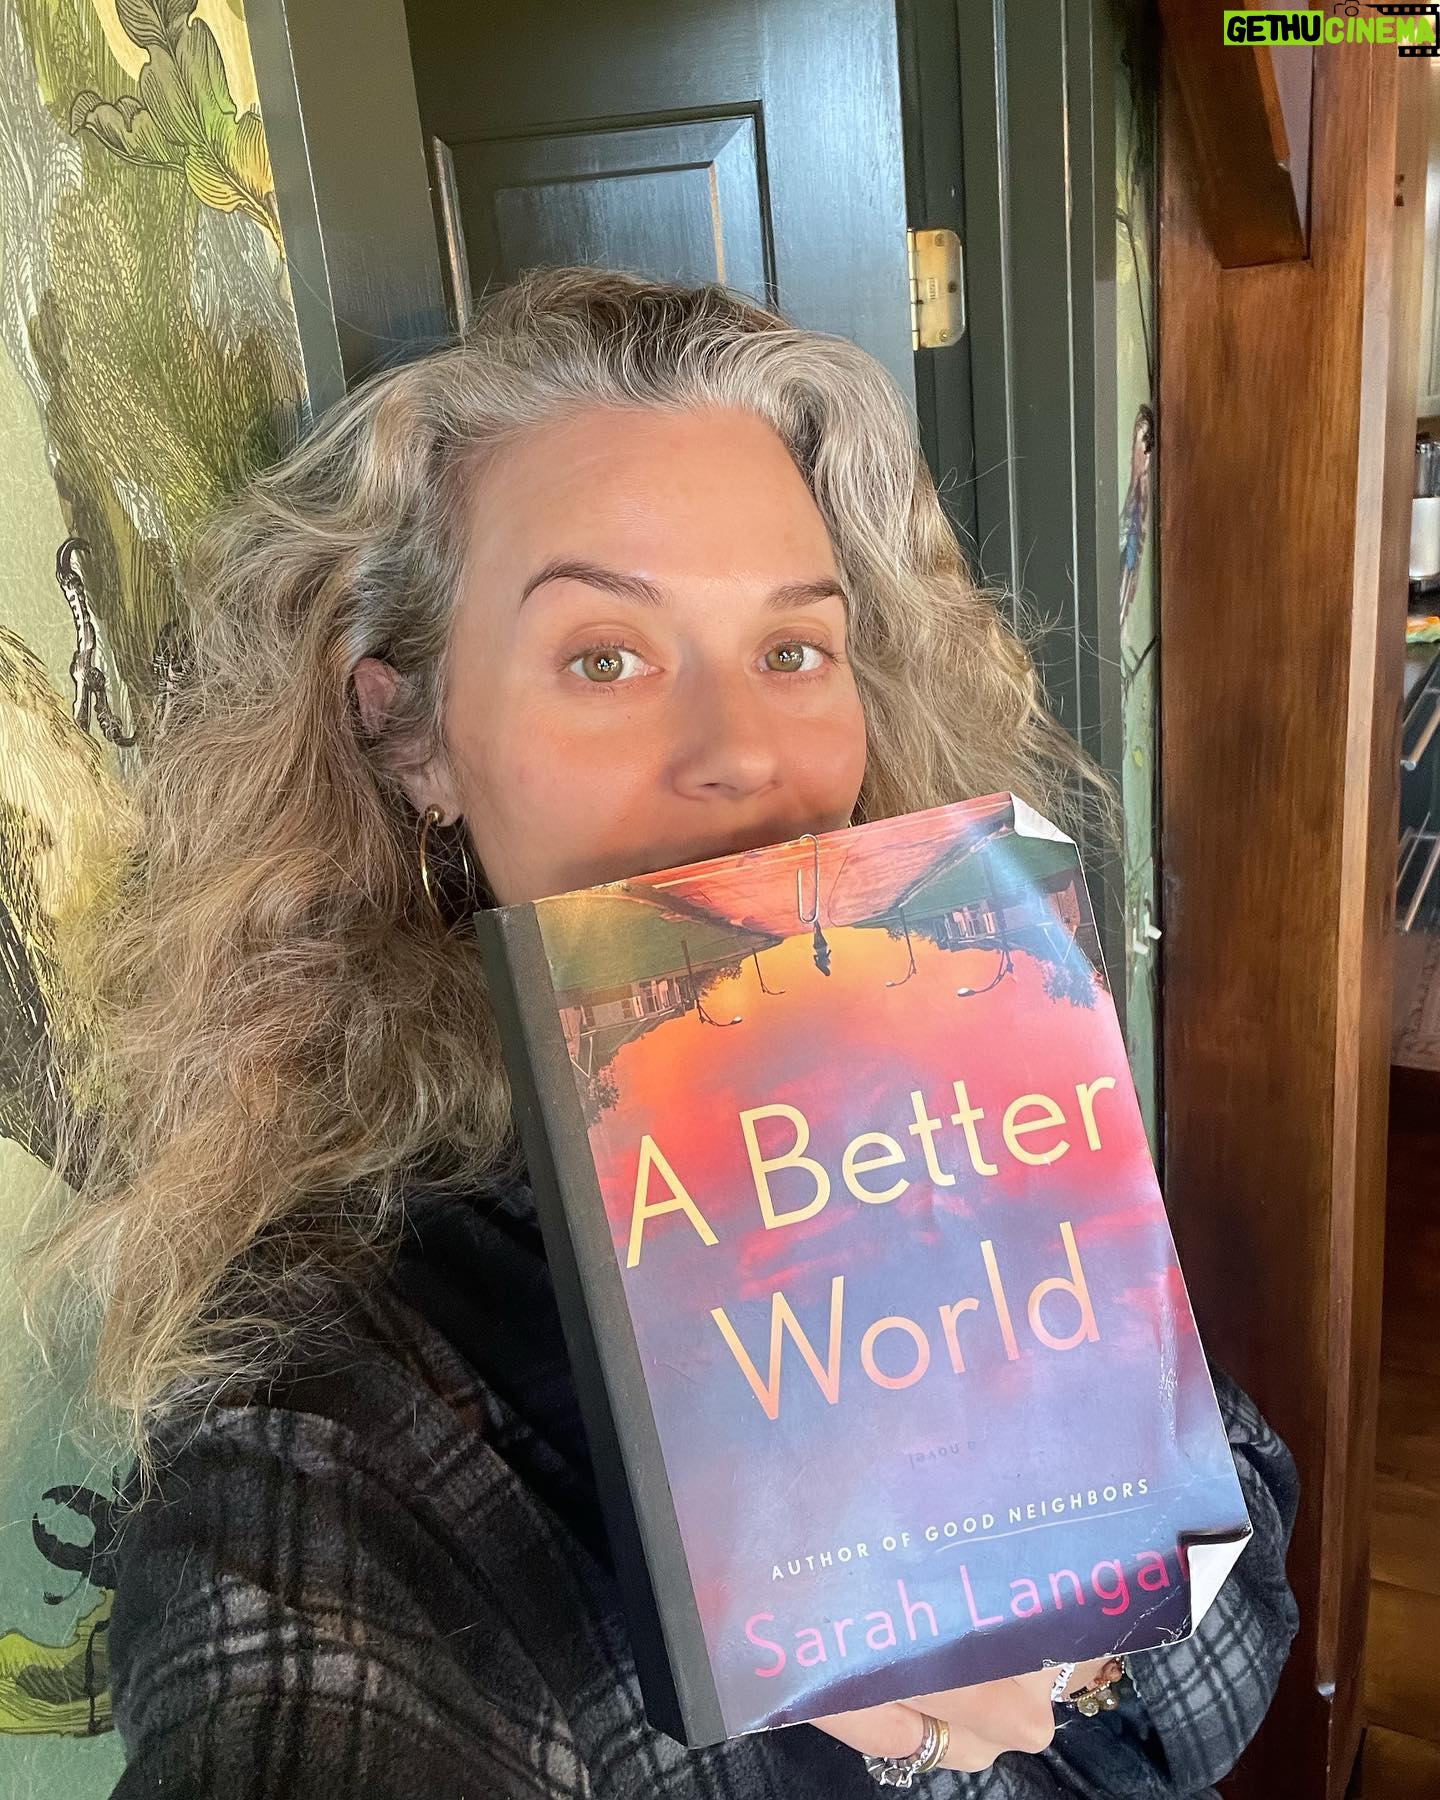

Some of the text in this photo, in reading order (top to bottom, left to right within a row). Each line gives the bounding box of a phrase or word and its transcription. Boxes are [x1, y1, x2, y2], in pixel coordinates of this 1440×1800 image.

[625, 1076, 1117, 1269] A Better
[710, 1220, 1101, 1421] World
[770, 1478, 1150, 1581] AUTHOR OF GOOD NEIGHBORS
[744, 1578, 940, 1679] Sarah
